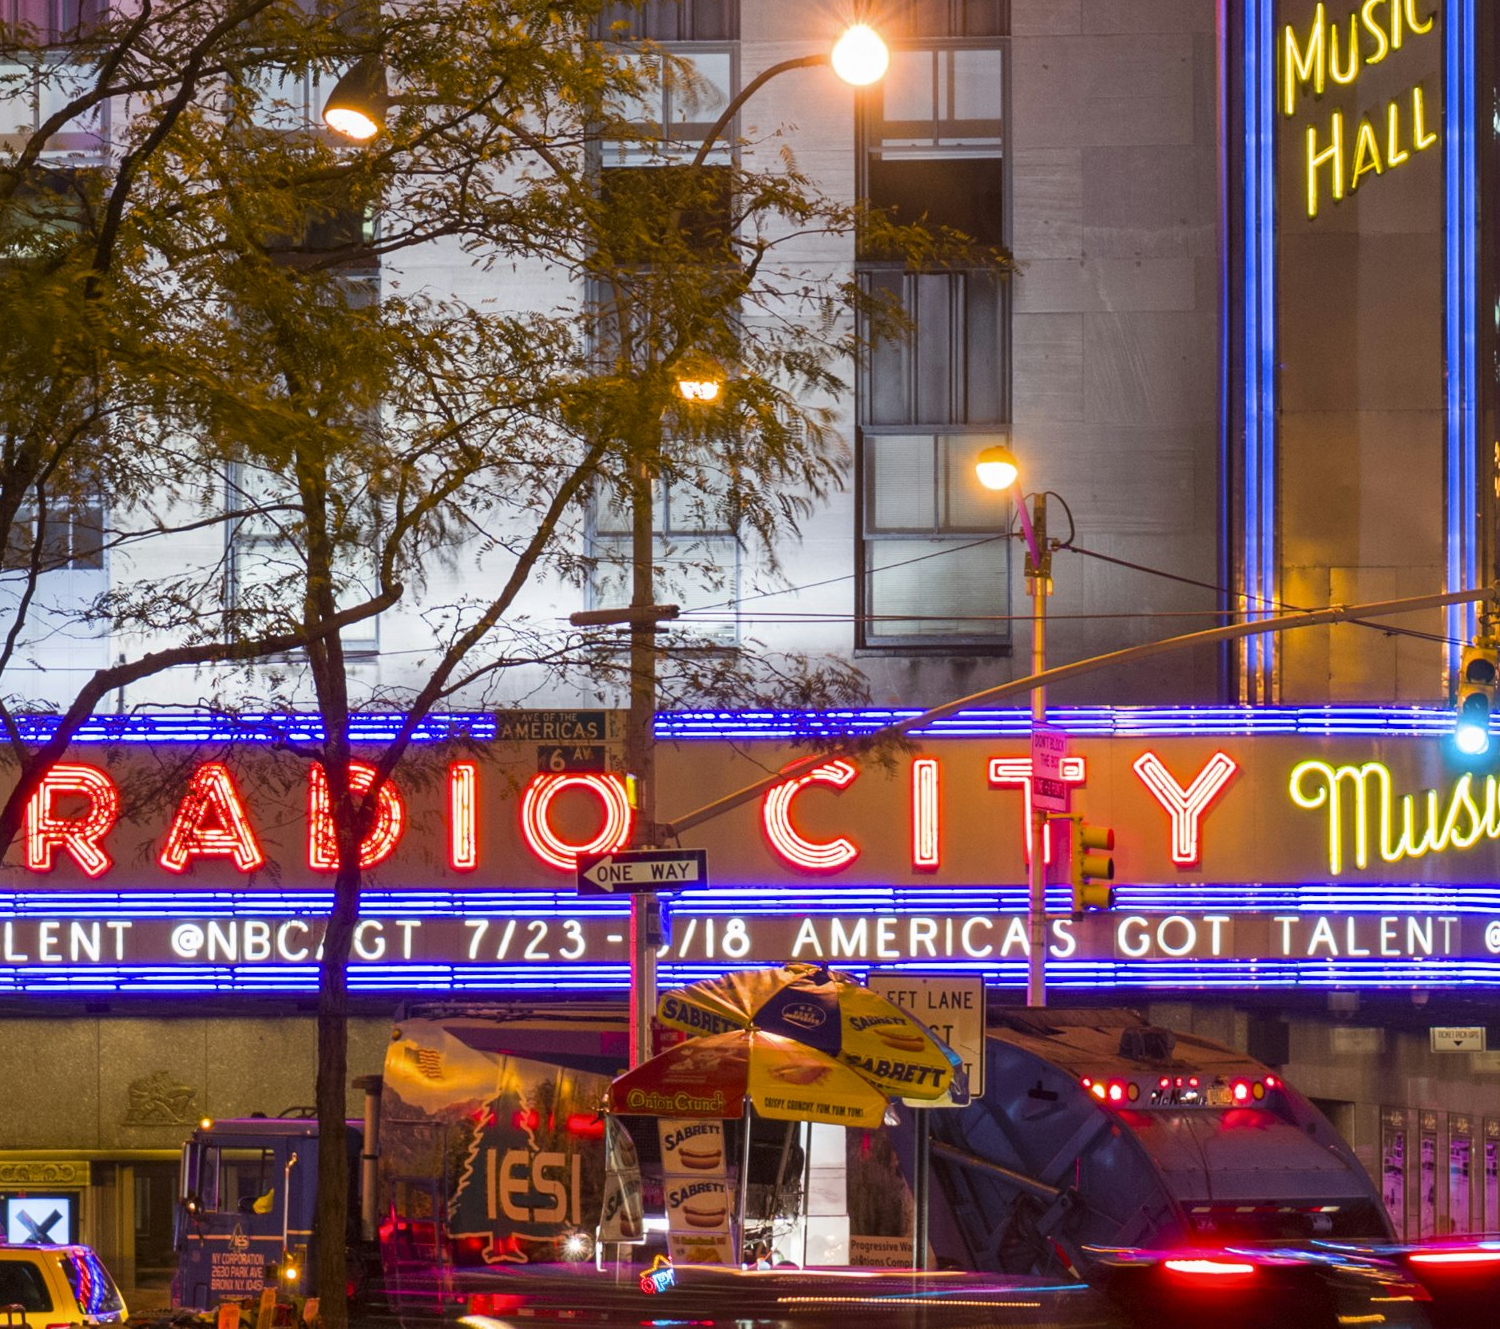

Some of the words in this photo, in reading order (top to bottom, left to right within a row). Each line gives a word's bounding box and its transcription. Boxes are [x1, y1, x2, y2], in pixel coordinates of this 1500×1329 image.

[1306, 86, 1437, 218] HALL
[523, 713, 540, 722] AVE
[543, 713, 555, 722] OF
[559, 713, 578, 722] THE
[502, 722, 598, 738] AMERICAS
[550, 749, 565, 771] 6
[23, 759, 636, 877] RADIO
[762, 749, 1240, 874] CITY
[596, 865, 633, 883] ONE
[651, 862, 690, 881] WAY
[465, 918, 587, 961] 7/23
[657, 918, 751, 958] /18
[1117, 915, 1231, 957] GOT
[1272, 914, 1458, 956] TALENT
[928, 992, 973, 1010] LANE
[629, 1090, 674, 1110] Onion
[675, 1091, 725, 1112] Crunch
[665, 1124, 721, 1151] SABRETT
[487, 1149, 582, 1225] IESI
[669, 1182, 725, 1208] SABRETT
[851, 1239, 899, 1253] Progressive
[222, 1253, 264, 1266] CORPORATION
[851, 1255, 884, 1267] olutions
[231, 1266, 248, 1278] PARK
